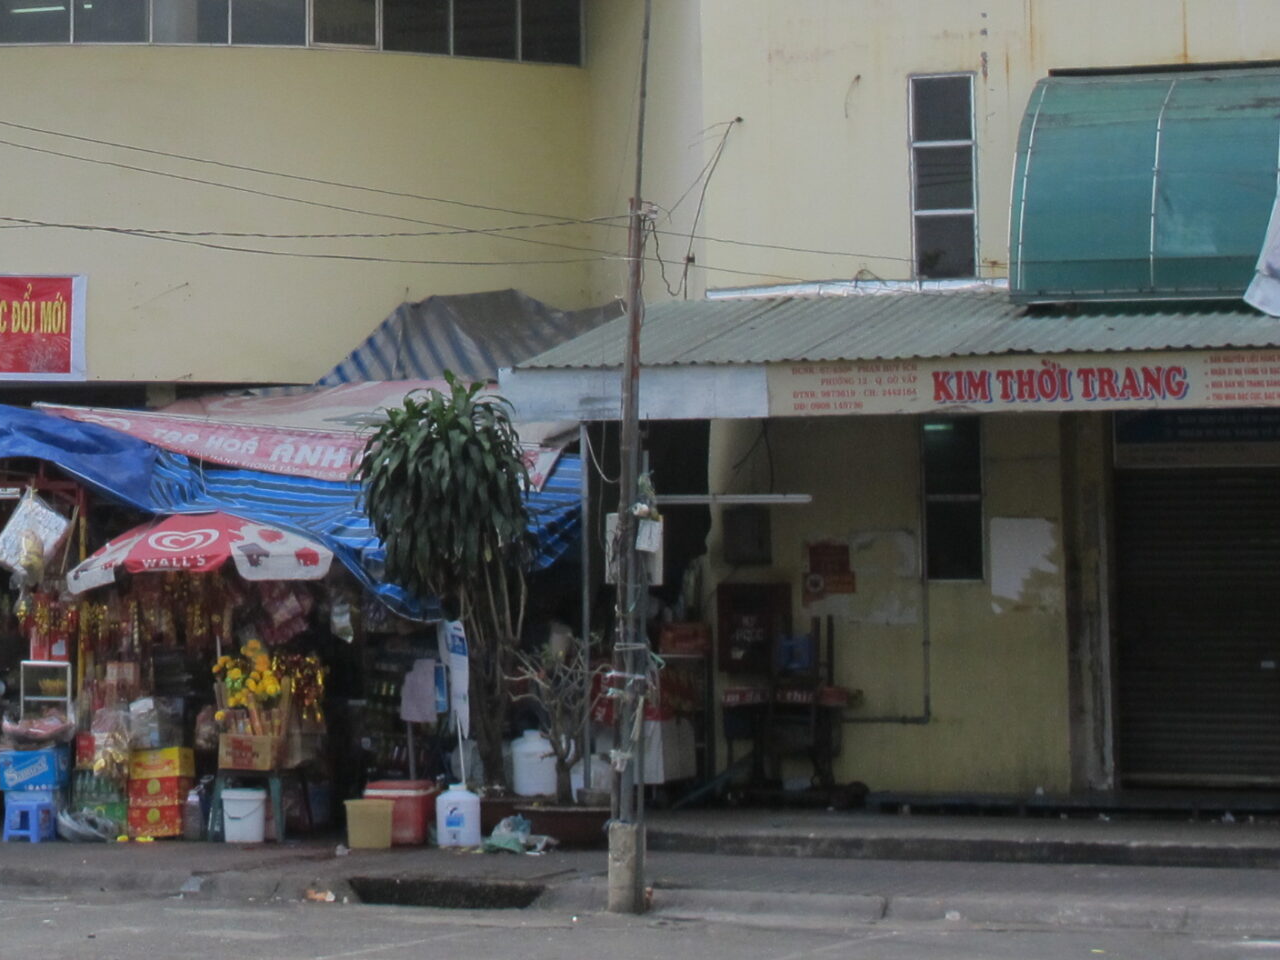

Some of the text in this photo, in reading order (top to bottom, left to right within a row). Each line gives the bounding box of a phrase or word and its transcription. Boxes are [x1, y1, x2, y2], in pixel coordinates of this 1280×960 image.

[931, 359, 1190, 403] KIM THỜI TRANG
[141, 553, 207, 569] WALL'S
